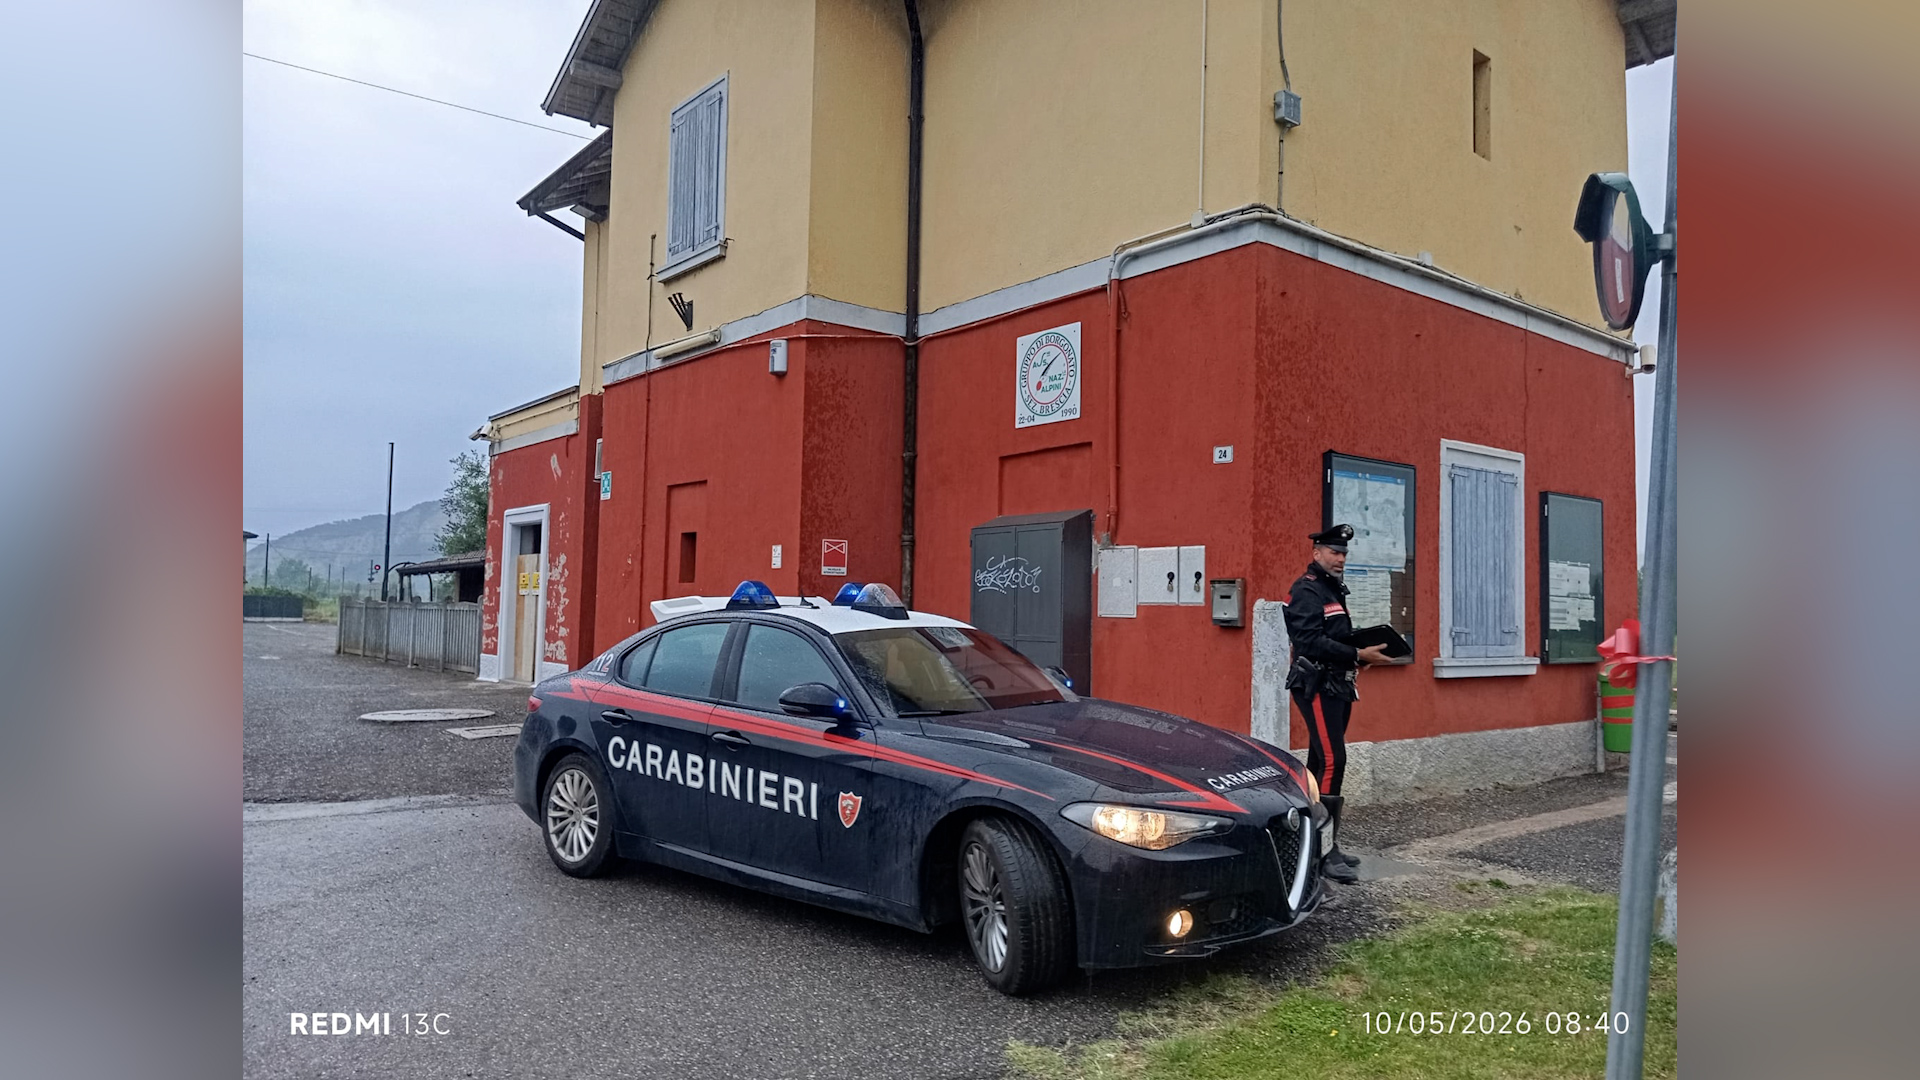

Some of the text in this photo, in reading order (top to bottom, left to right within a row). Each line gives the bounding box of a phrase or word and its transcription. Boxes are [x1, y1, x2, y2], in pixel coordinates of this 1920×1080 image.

[1021, 335, 1075, 388] GRUPPO DI BORGONATO
[1041, 383, 1062, 393] ALPINI
[1040, 387, 1071, 414] BRESCIA
[1061, 406, 1077, 417] 1990
[1018, 415, 1035, 424] 22-04
[1218, 449, 1227, 459] 24
[592, 653, 613, 672] 112
[608, 736, 818, 820] CARABINIERI
